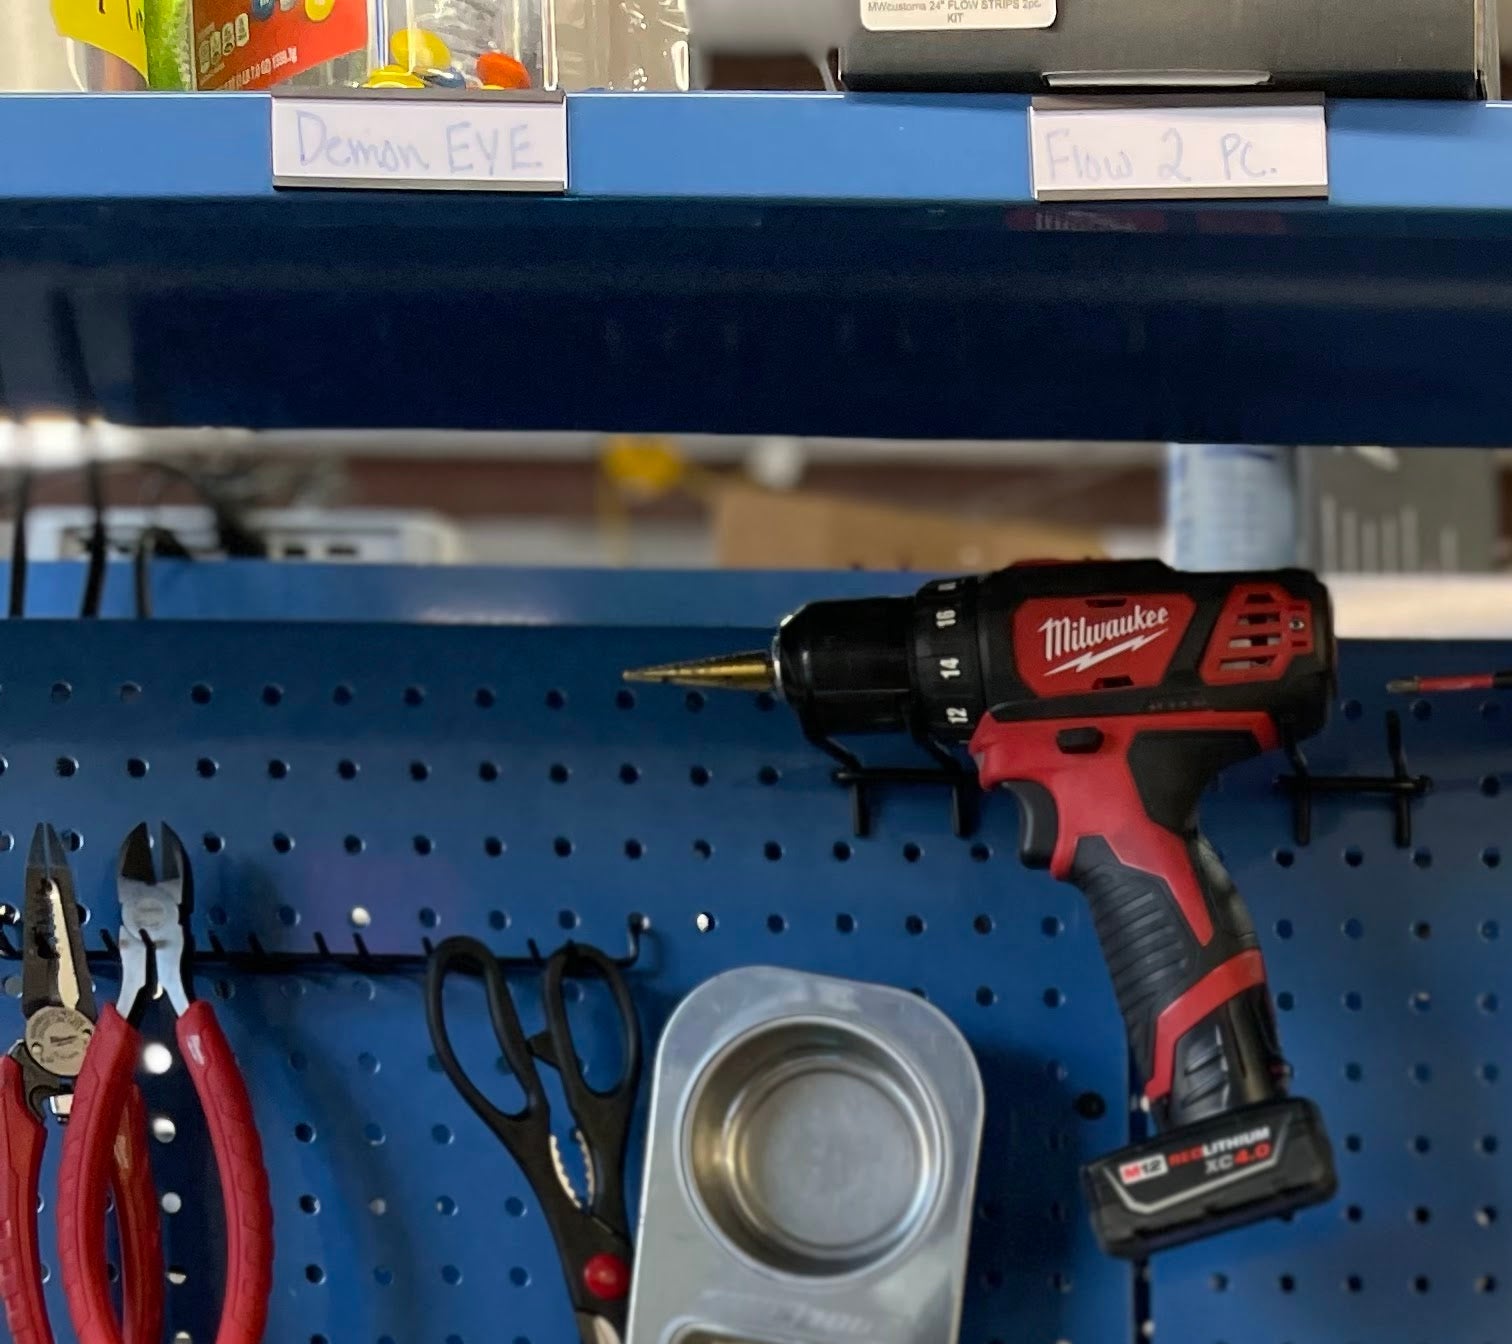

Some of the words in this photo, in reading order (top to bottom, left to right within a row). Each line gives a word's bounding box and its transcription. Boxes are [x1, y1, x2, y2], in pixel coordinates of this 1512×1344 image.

[947, 13, 964, 23] KIT
[948, 0, 979, 10] FLOW
[982, 0, 1020, 9] STRIPS
[296, 111, 430, 171] Demon
[446, 123, 543, 174] EYE
[1046, 129, 1132, 182] Flow
[1159, 128, 1191, 180] 2
[1038, 605, 1169, 661] Milwaukee
[1123, 1158, 1163, 1180] M12
